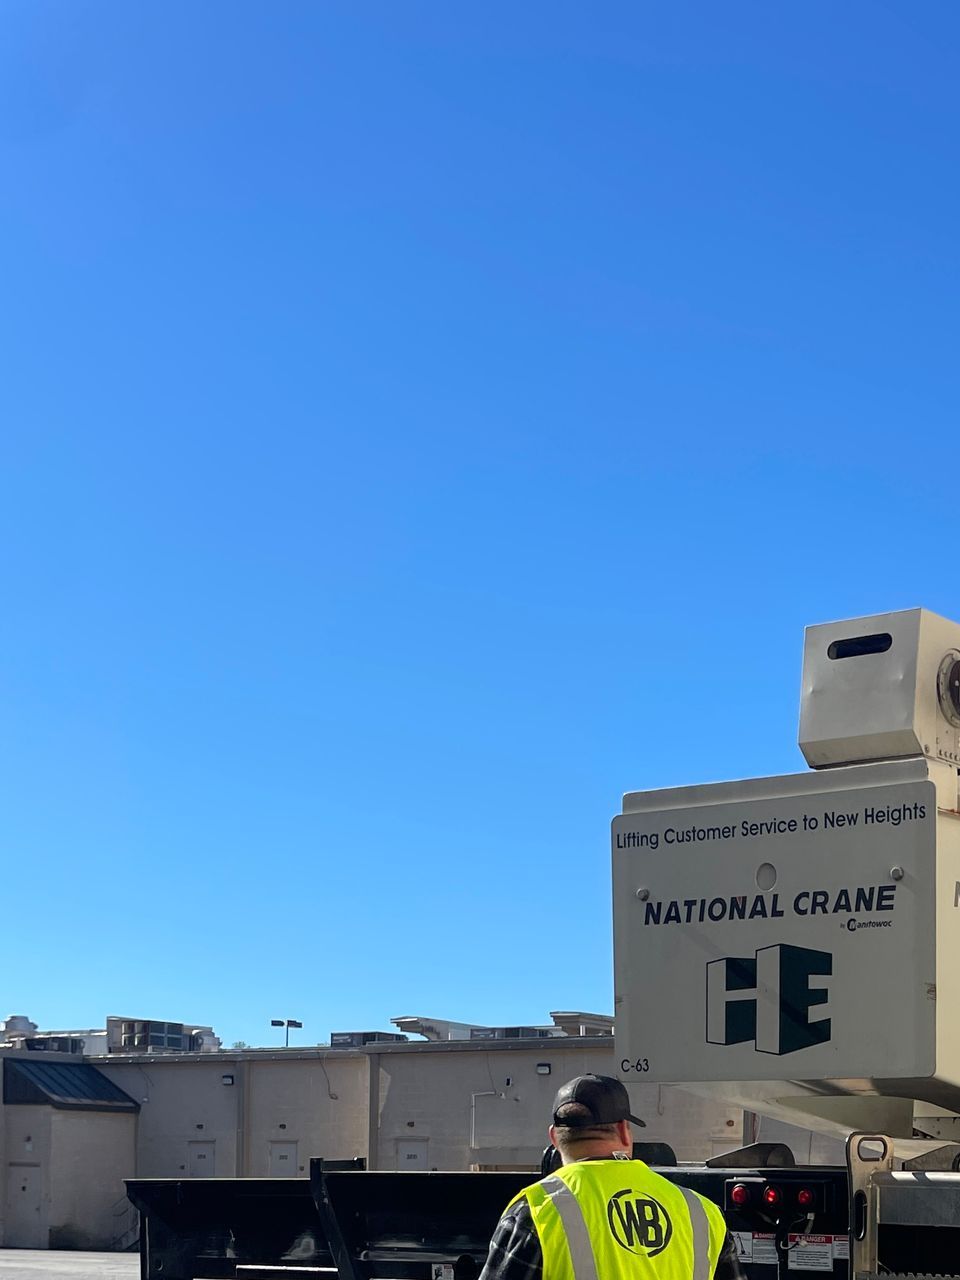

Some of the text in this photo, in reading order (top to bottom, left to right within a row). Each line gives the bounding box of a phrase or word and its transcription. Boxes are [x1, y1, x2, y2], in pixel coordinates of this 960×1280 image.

[616, 802, 926, 850] Lifting Customer Service to New Heights
[644, 885, 897, 926] NATIONAL CRANE
[621, 1058, 650, 1073] C-63
[611, 1198, 664, 1248] WB
